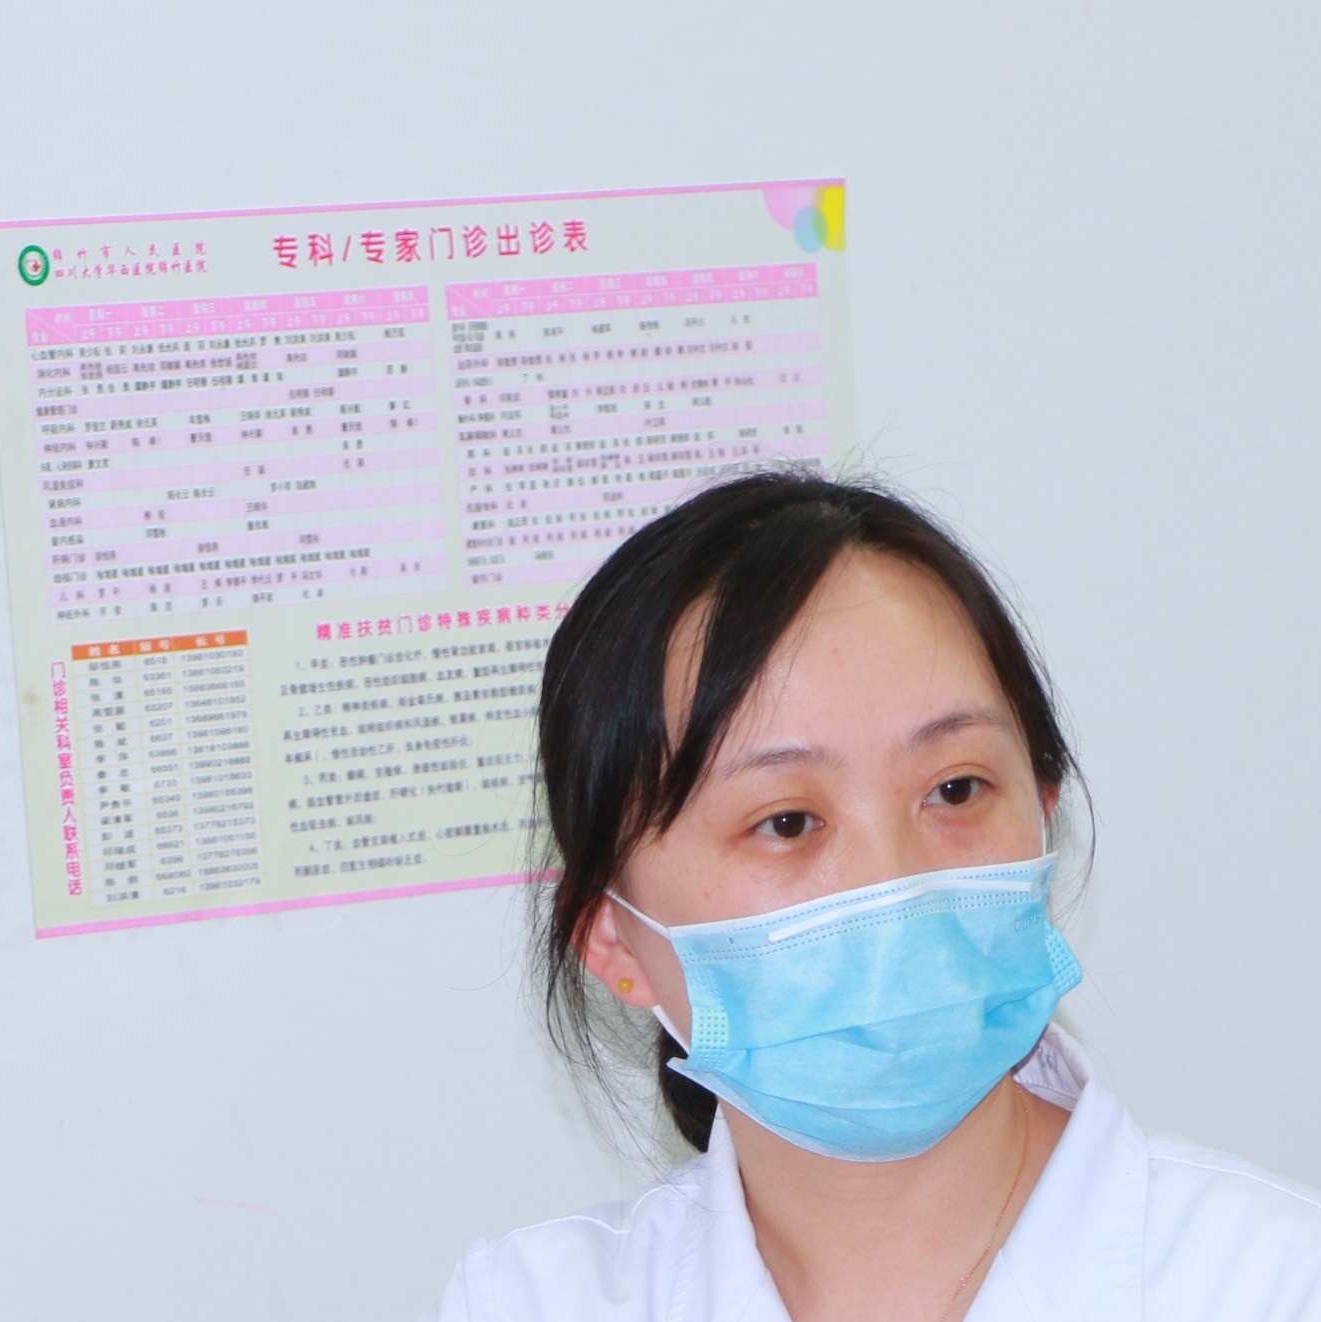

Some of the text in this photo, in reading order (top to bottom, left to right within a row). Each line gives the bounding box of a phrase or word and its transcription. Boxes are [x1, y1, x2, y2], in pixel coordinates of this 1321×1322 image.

[273, 219, 589, 268] 专科/专家门诊出诊表
